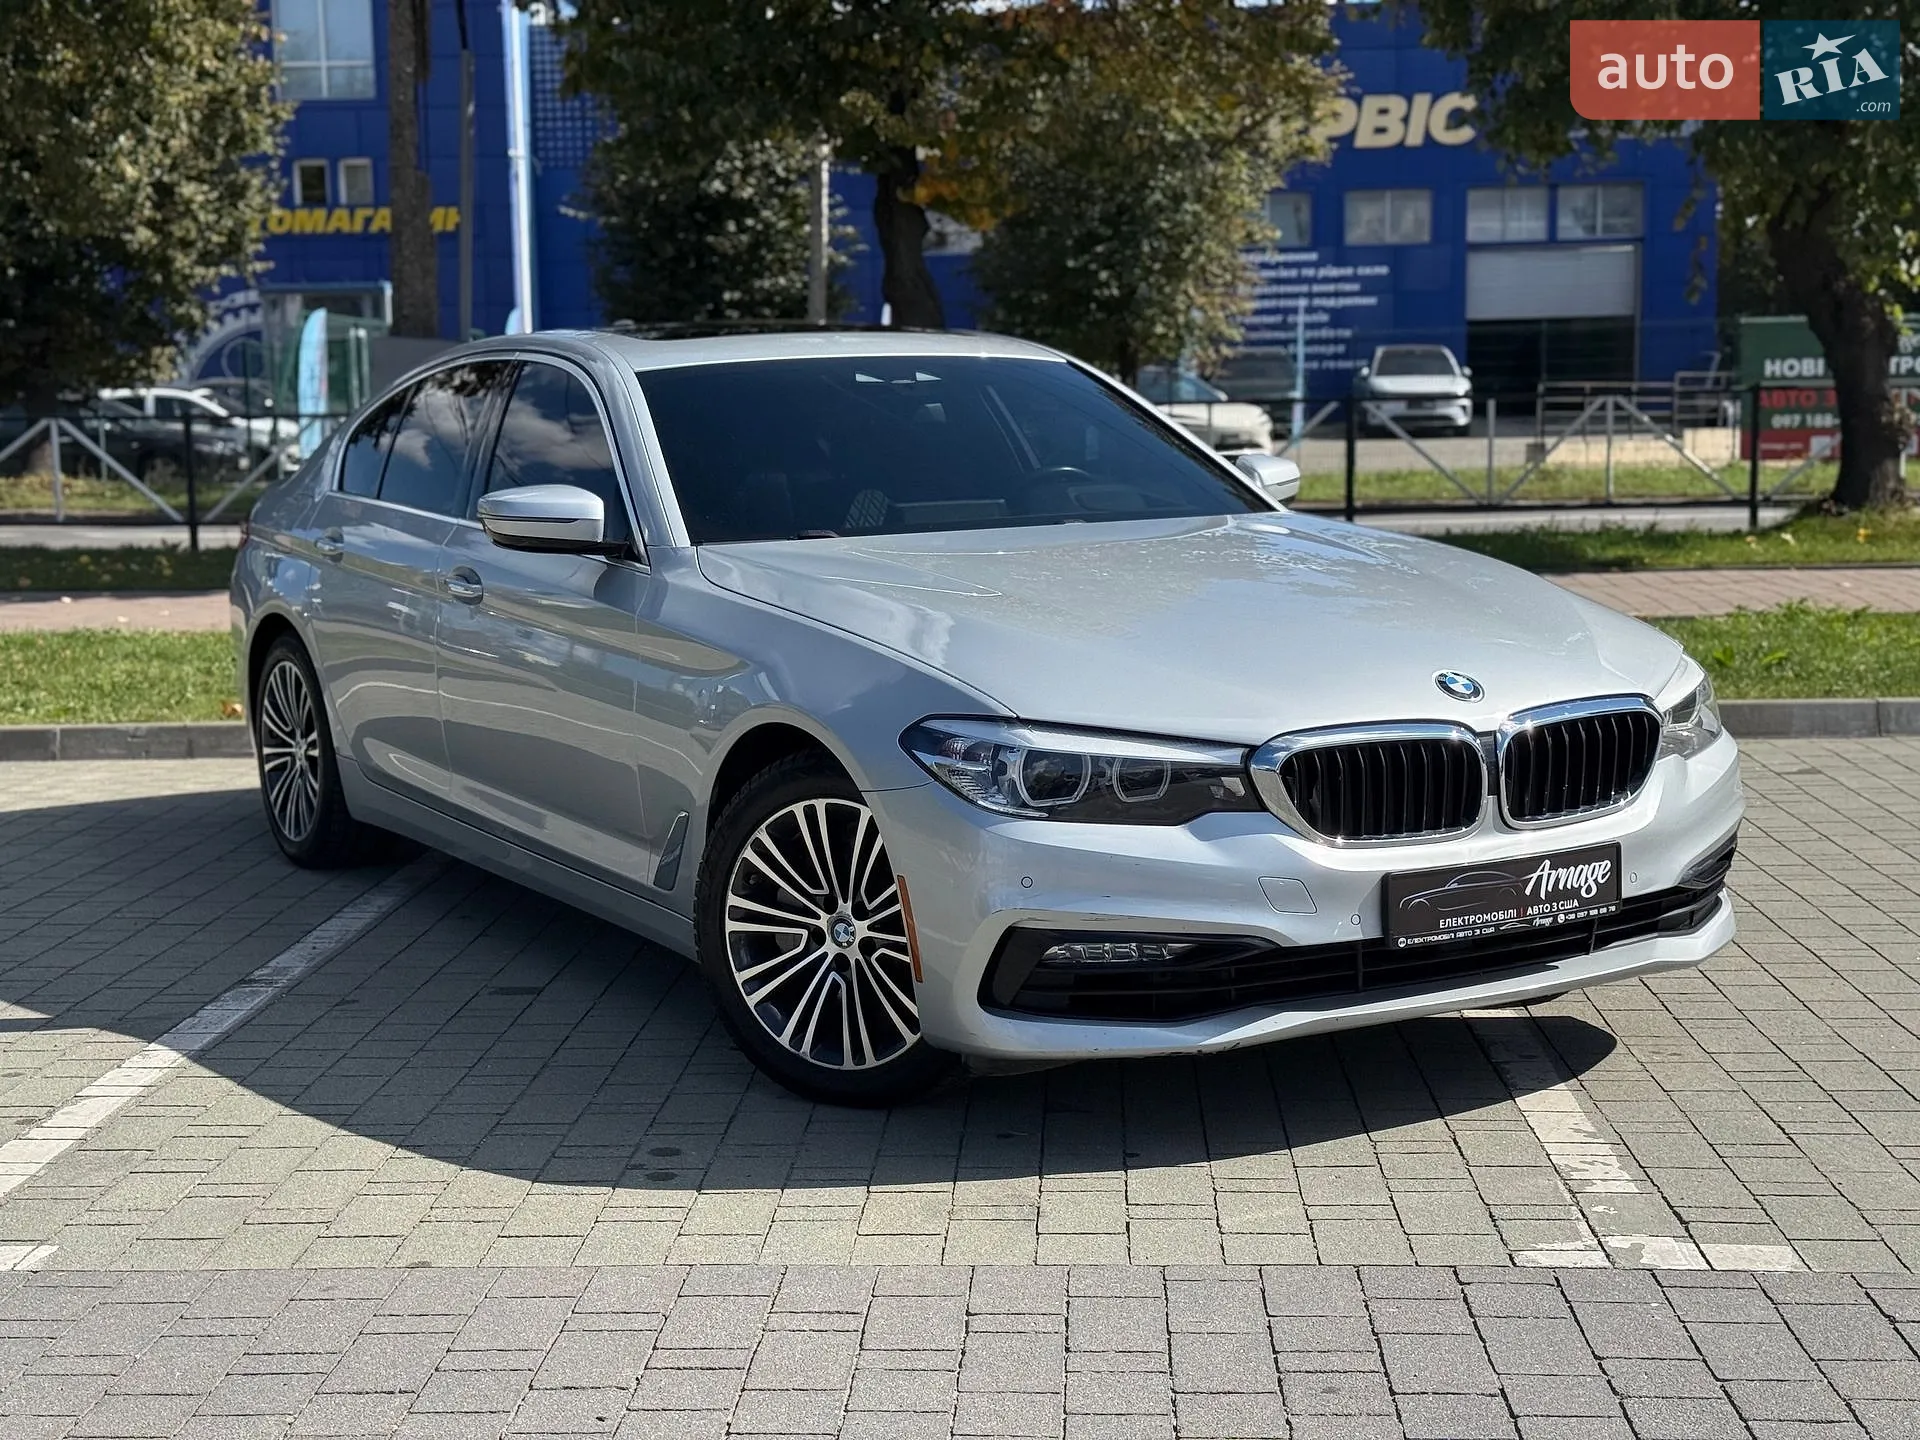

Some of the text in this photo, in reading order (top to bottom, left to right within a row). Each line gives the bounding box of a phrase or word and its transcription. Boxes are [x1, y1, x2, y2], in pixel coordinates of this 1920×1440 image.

[1763, 356, 1826, 379] НОВІ
[1759, 388, 1818, 409] АВТО
[1523, 859, 1612, 900] Arnage
[1439, 898, 1580, 929] ЕЛЕКТРОМОБІЛІ АВТО З США
